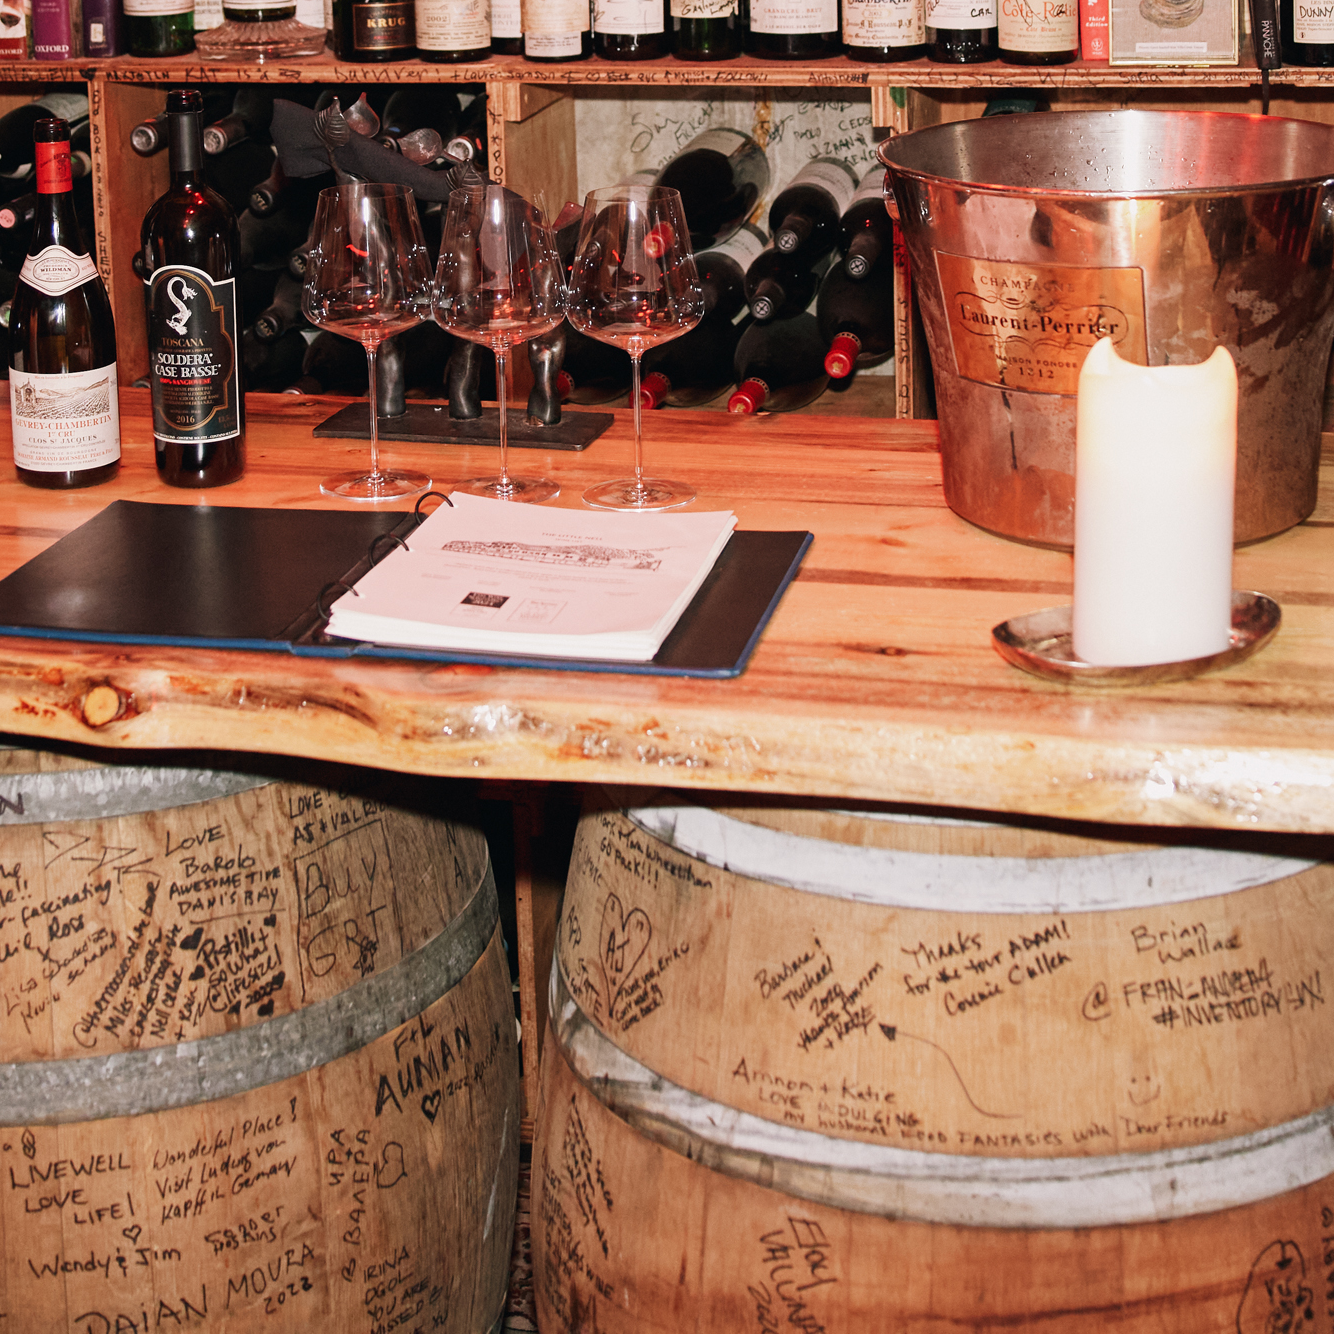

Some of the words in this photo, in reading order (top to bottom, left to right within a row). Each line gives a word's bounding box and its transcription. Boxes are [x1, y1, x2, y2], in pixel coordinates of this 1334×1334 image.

[366, 16, 407, 29] KRUG
[35, 44, 70, 54] OXFORD
[162, 337, 204, 347] TOSCANA
[155, 365, 178, 378] CASE
[15, 414, 112, 432] GEVREY-CHAMBERTIN
[175, 415, 195, 424] 2016
[166, 824, 224, 856] LOVE
[1131, 919, 1208, 954] Brian
[24, 1188, 88, 1214] LOVE
